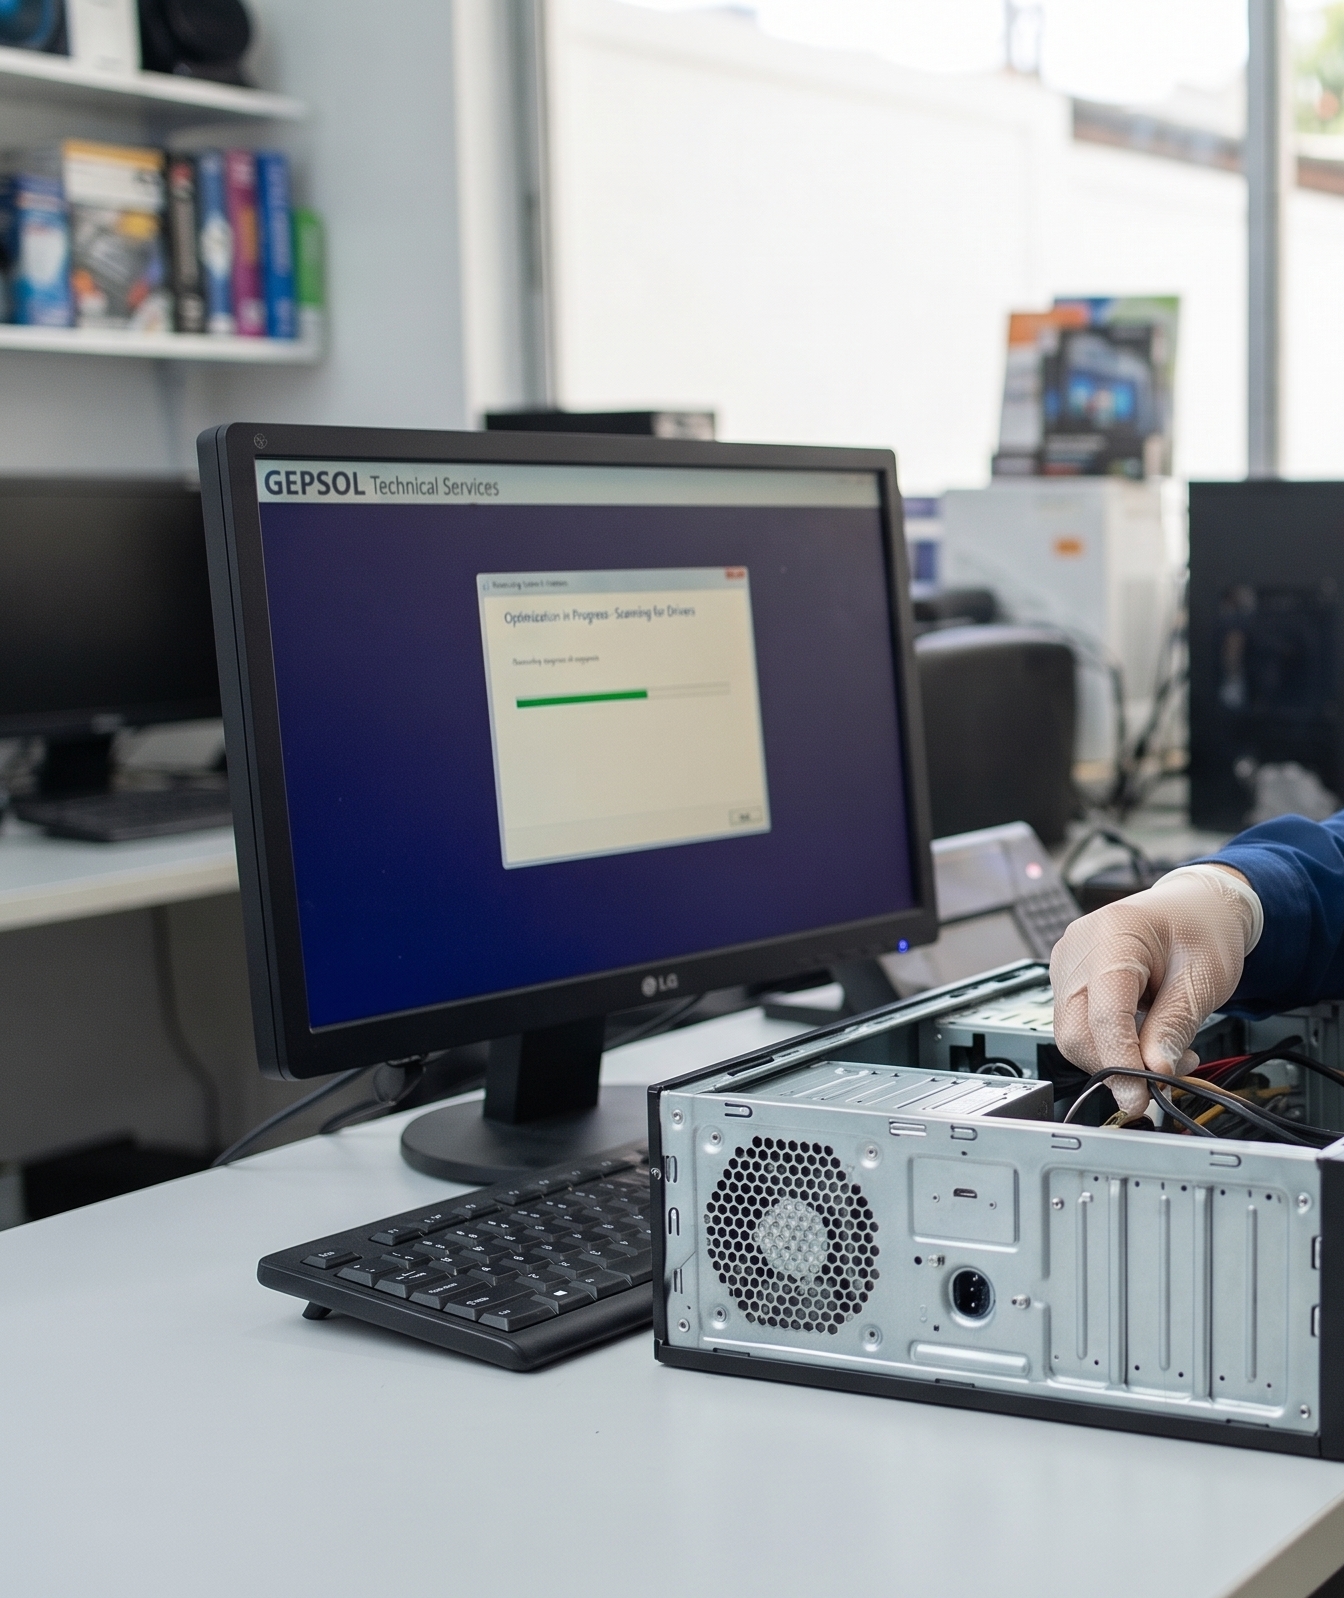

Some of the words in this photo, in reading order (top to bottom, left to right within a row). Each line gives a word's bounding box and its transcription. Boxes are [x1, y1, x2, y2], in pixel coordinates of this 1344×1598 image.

[264, 469, 366, 496] GEPSOL
[370, 475, 439, 496] Technical
[443, 476, 500, 497] Services
[658, 972, 679, 993] LG
